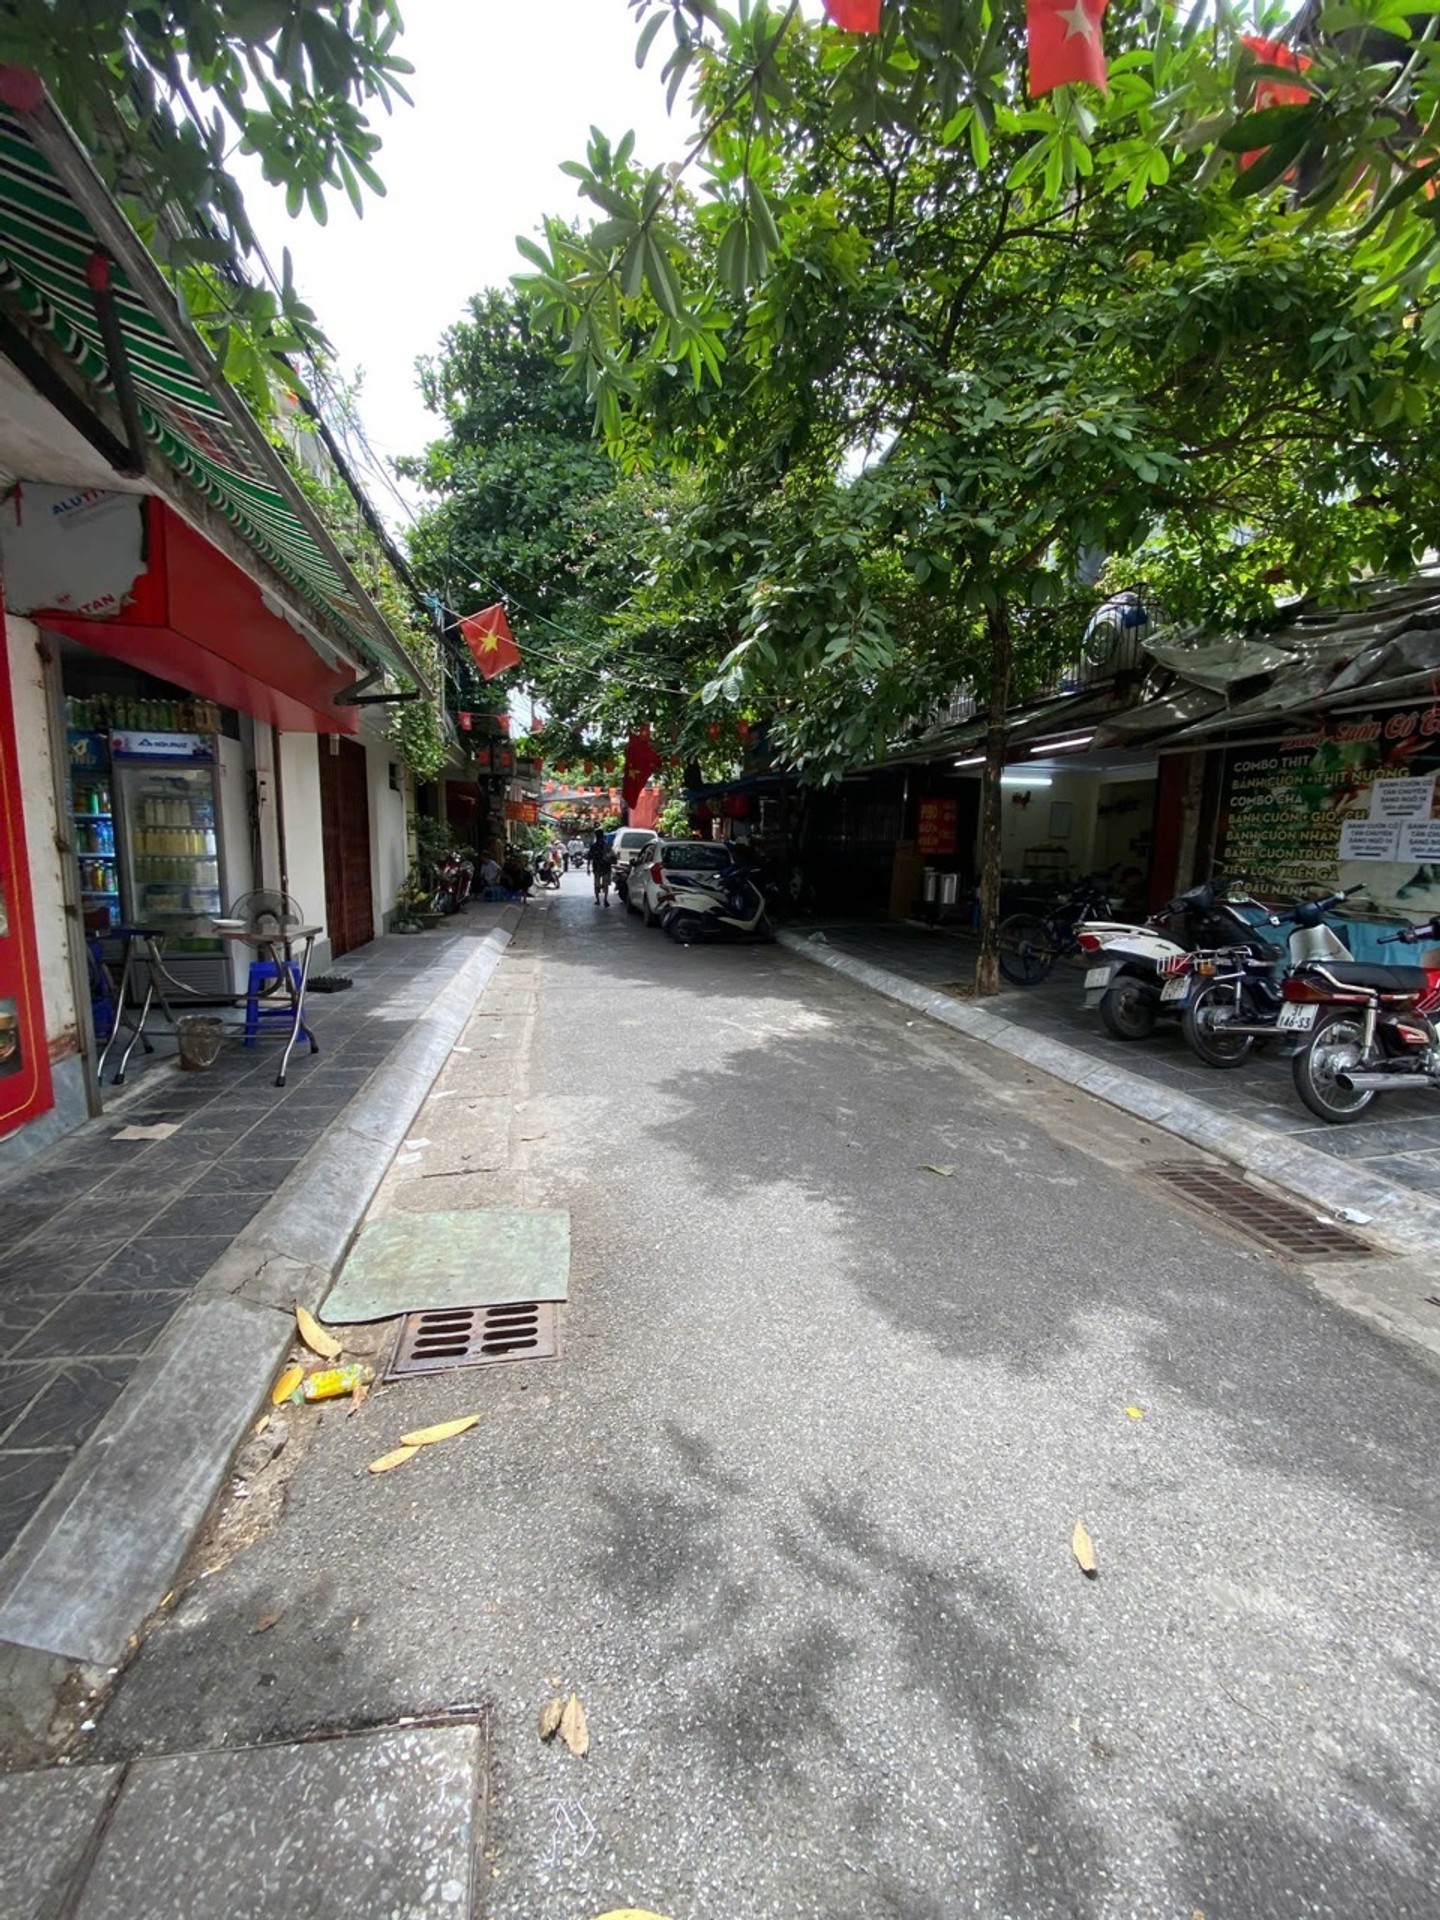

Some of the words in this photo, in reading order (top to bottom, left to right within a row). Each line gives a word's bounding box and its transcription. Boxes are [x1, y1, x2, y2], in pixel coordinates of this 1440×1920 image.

[1234, 759, 1278, 772] COMBO
[1231, 775, 1263, 790] BÁNH
[1266, 772, 1304, 787] CUỐN
[1316, 769, 1349, 786] THỊT
[1352, 766, 1410, 782] NƯỚNG
[1231, 795, 1273, 807] COMBO
[1228, 811, 1260, 824] BÁNH
[1262, 808, 1300, 823] CUỐN
[1226, 829, 1257, 841] BÁNH
[1259, 826, 1297, 841] CUỐN
[1258, 844, 1295, 859] CUỐN
